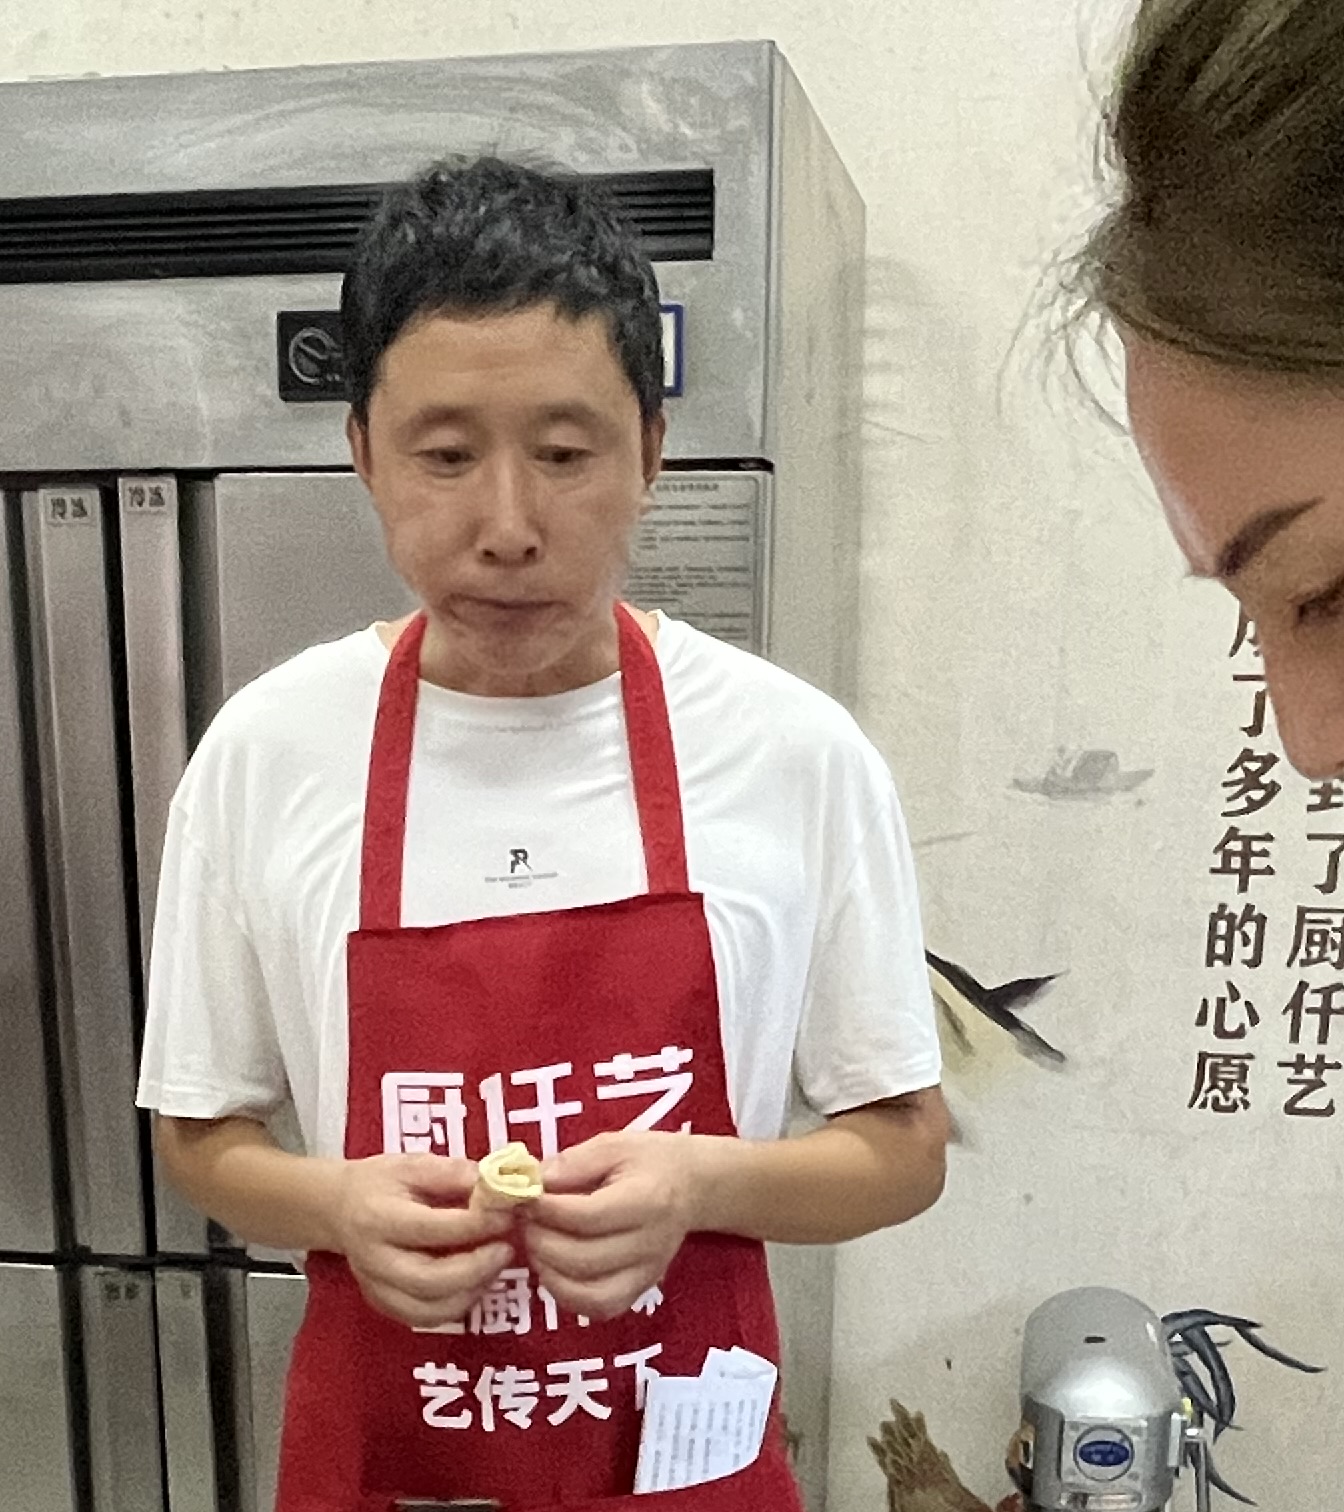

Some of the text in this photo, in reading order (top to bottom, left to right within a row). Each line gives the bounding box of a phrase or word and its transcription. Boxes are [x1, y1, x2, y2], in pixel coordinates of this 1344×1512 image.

[1187, 600, 1283, 1113] 了多年的心愿
[412, 1343, 663, 1432] 艺传天下
